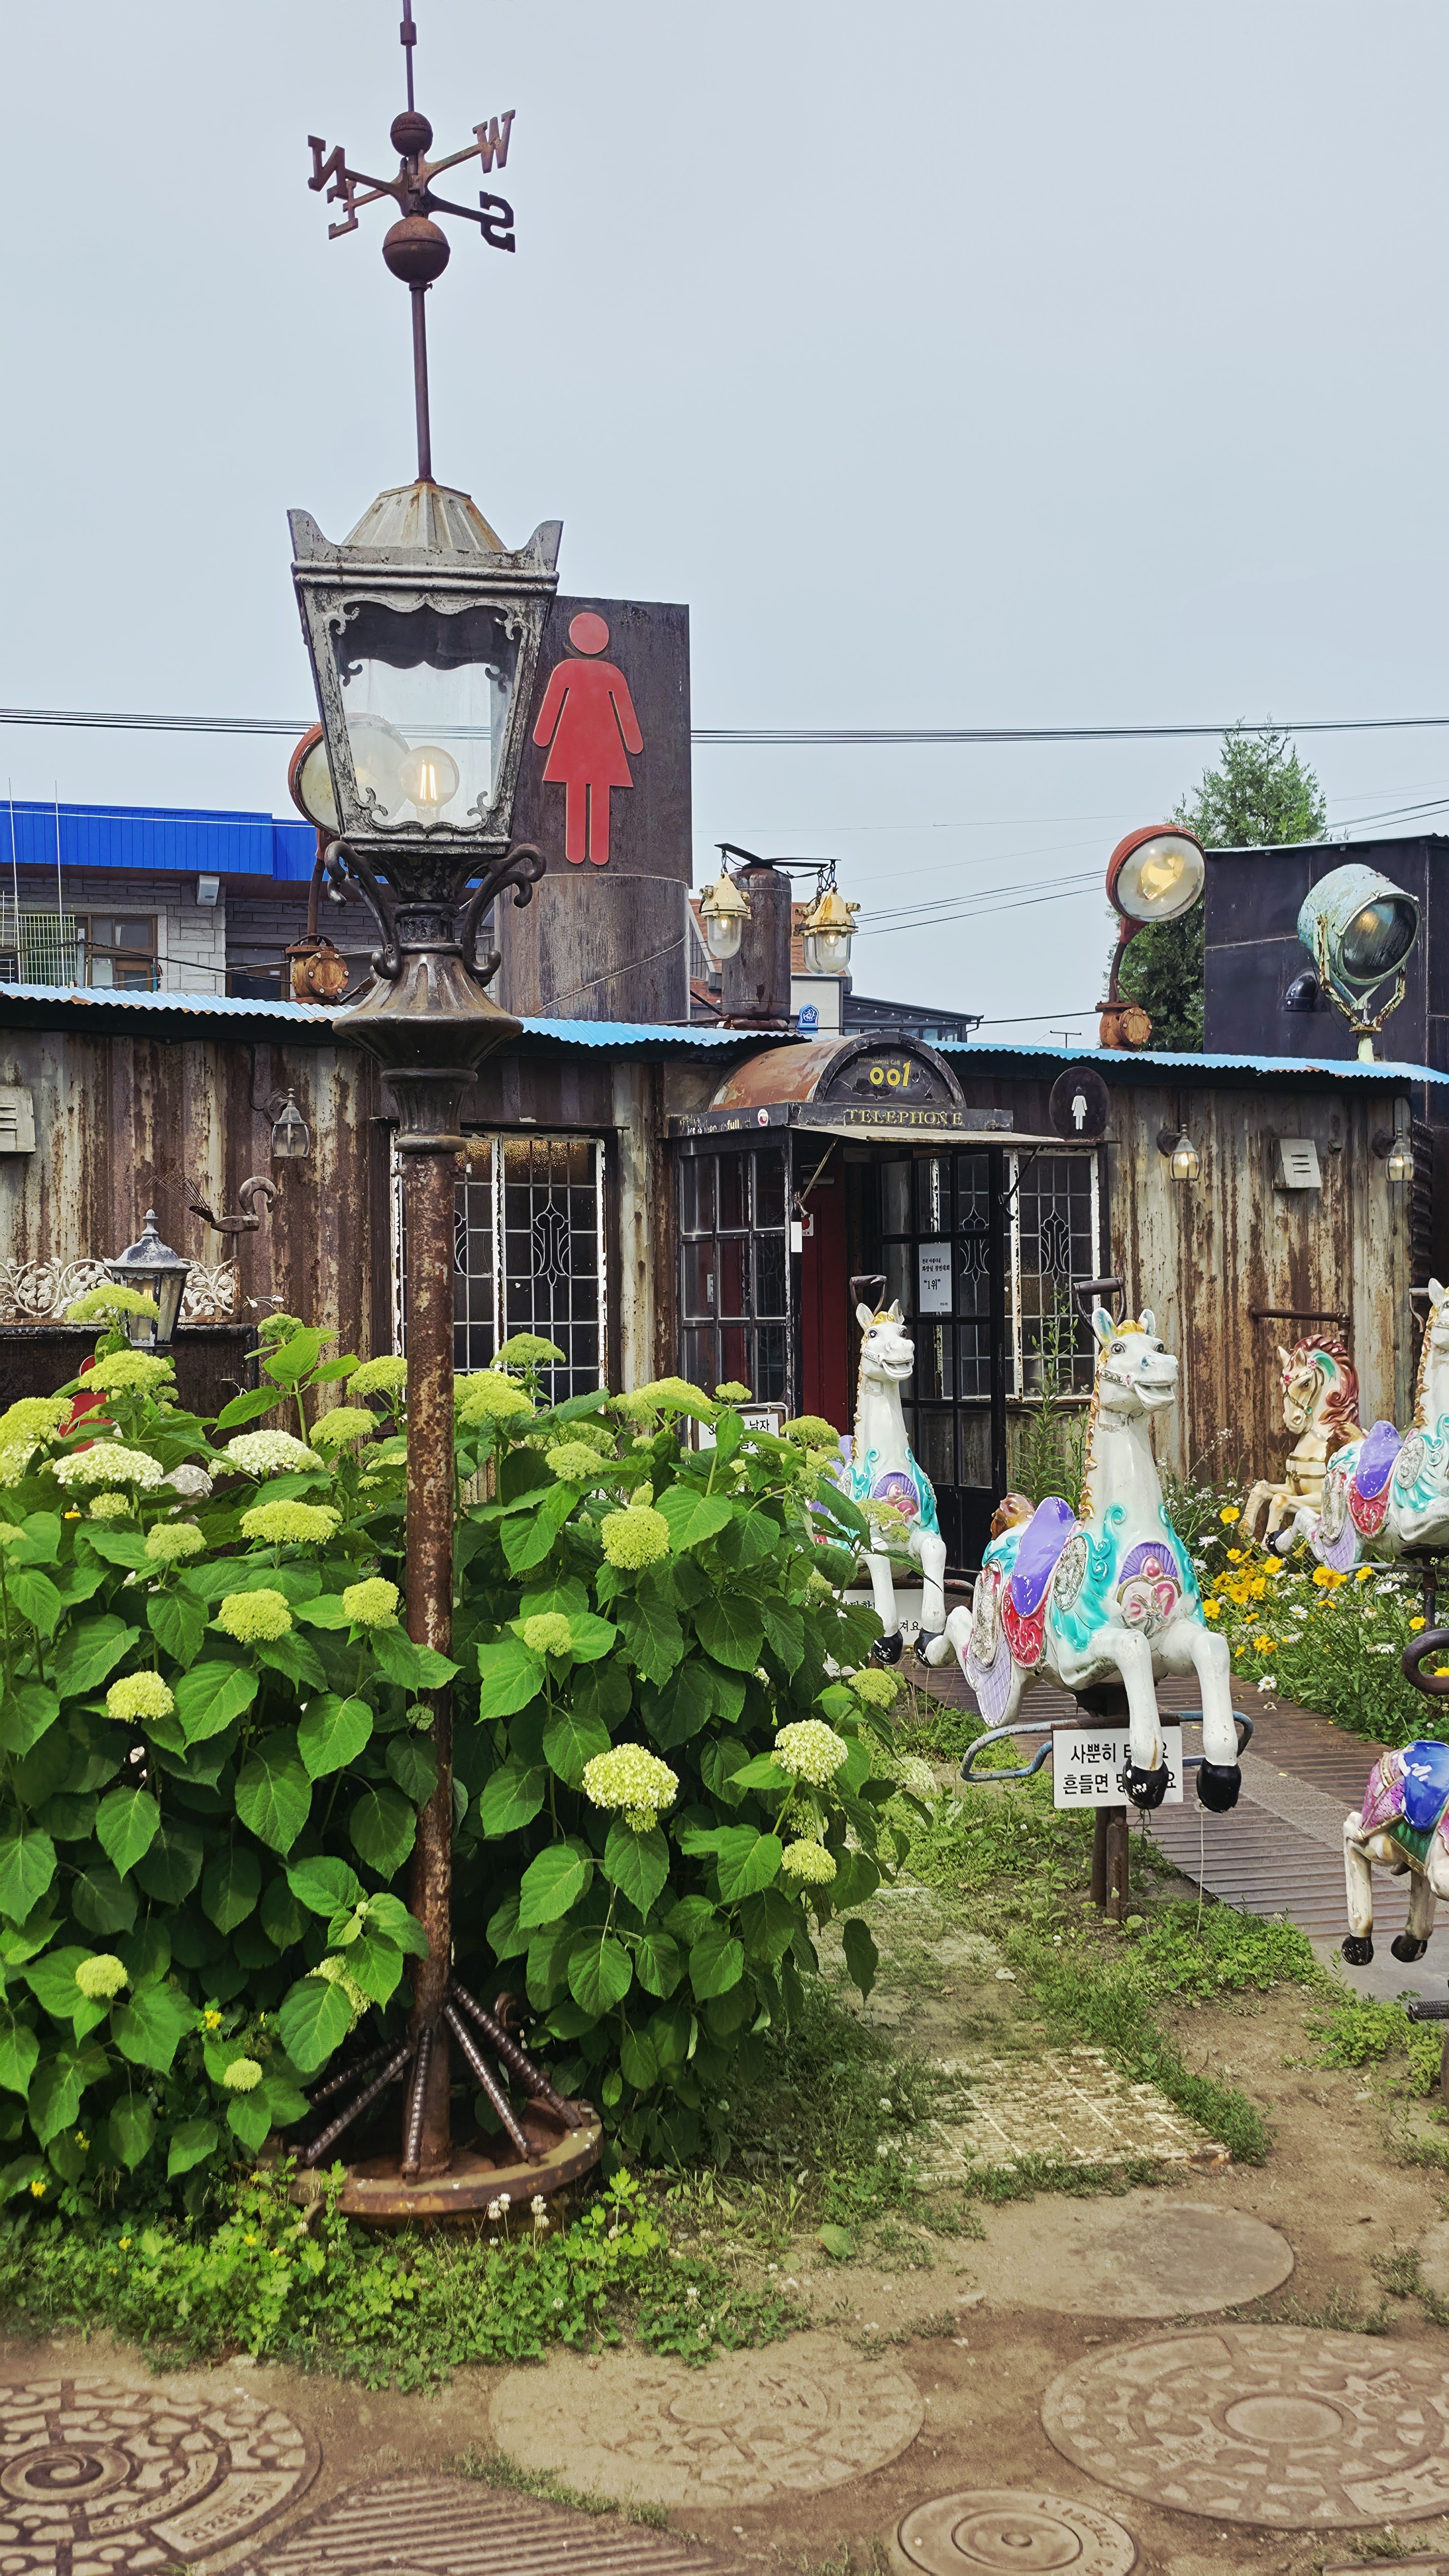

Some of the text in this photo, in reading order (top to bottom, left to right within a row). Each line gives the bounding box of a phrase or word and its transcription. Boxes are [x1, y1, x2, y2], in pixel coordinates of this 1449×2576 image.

[473, 109, 515, 174] W
[845, 1108, 963, 1126] TELEPHONE
[1071, 1743, 1116, 1764] 사뿐히
[1063, 1773, 1108, 1795] 흔들면
